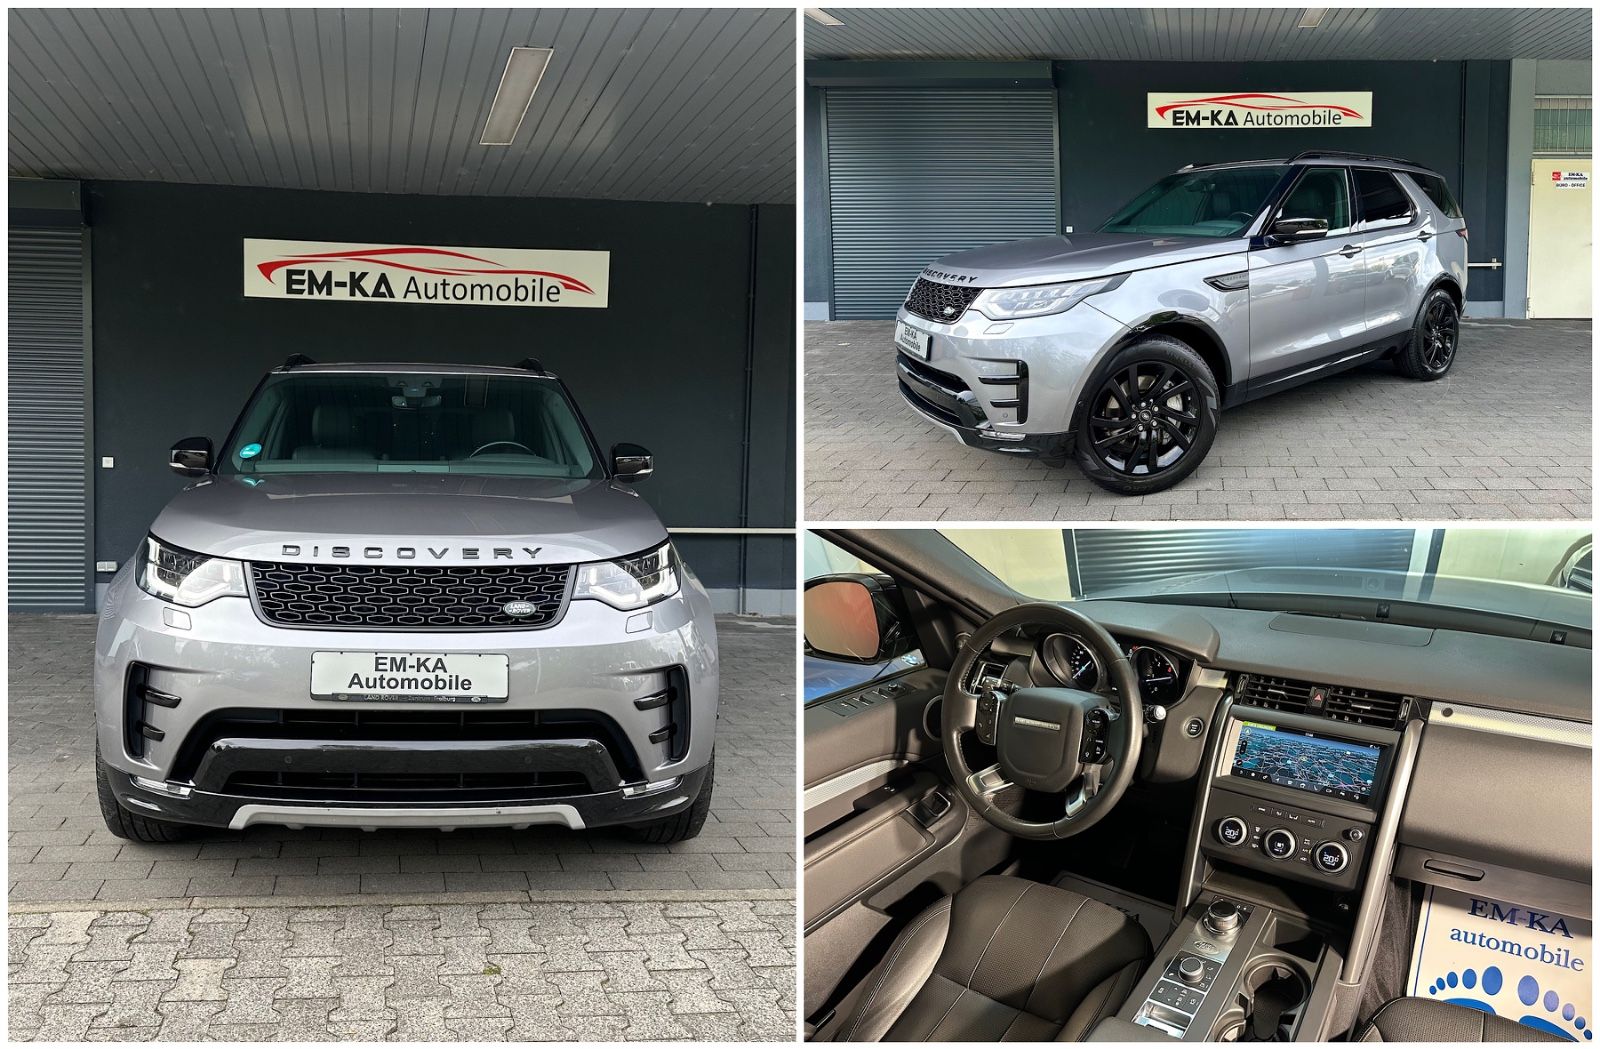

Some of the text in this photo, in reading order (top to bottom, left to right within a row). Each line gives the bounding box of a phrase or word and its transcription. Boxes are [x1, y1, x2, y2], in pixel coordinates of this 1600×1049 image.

[1172, 109, 1342, 126] EM-KA Automobile
[923, 268, 977, 283] DISCOVERY
[285, 268, 562, 304] EM-KA Automobile
[899, 334, 921, 352] Automobile
[283, 545, 542, 559] DISCOVERY
[375, 656, 447, 673] EM-KA
[348, 671, 473, 692] Automobile
[1467, 897, 1574, 939] EM-KA
[1450, 927, 1585, 972] automobile
